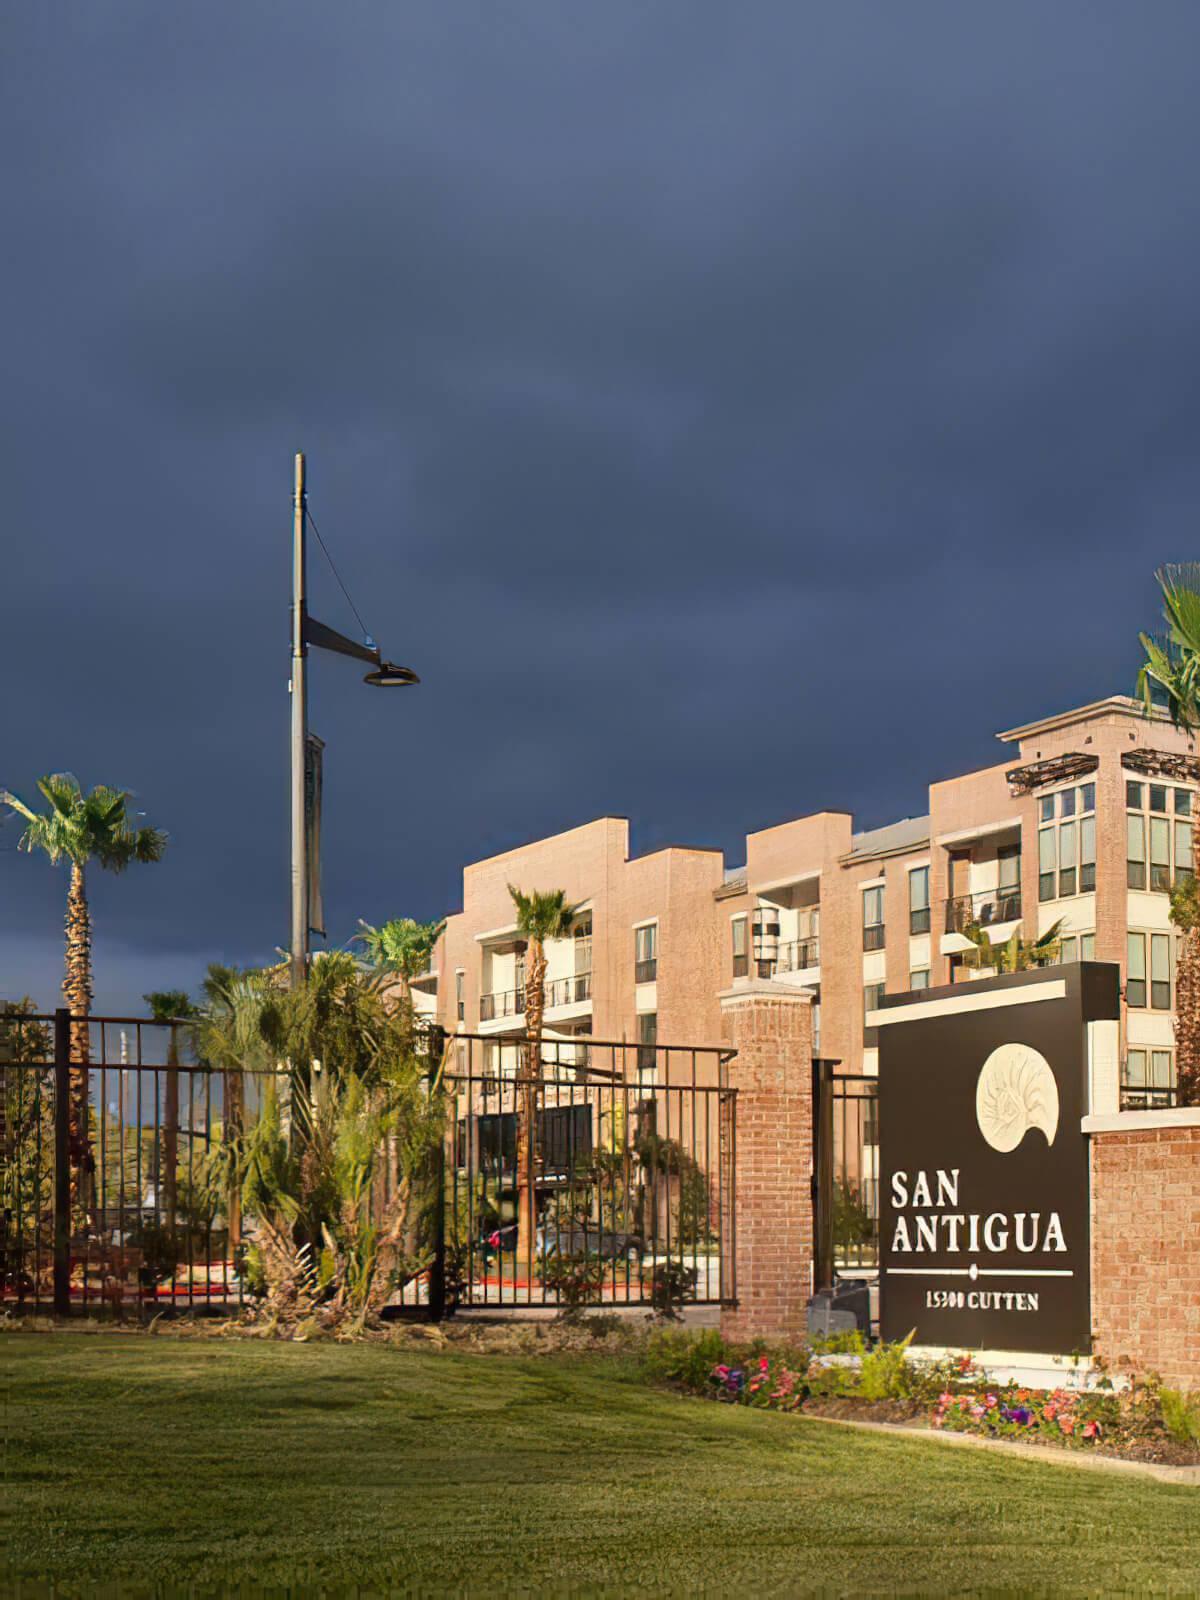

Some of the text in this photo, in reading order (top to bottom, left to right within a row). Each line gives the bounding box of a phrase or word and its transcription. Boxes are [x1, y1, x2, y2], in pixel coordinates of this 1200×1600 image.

[891, 1169, 960, 1209] SAN
[891, 1212, 1068, 1253] ANTIGUA
[967, 1291, 1039, 1311] CUTTEN
